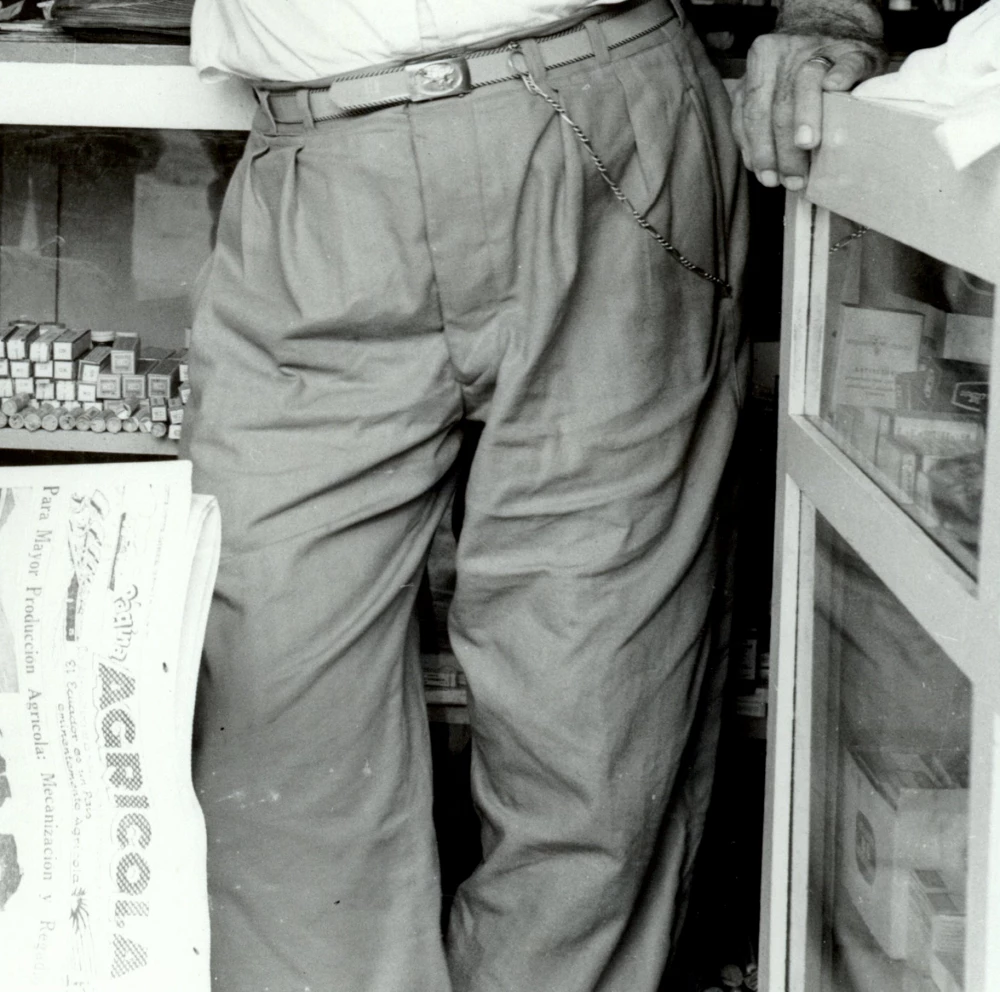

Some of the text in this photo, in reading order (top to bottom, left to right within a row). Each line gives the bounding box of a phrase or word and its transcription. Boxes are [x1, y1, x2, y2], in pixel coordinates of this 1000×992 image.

[35, 485, 60, 521] Para
[26, 528, 53, 577] Mayor
[97, 659, 153, 980] AGRICOLA
[37, 893, 55, 905] y
